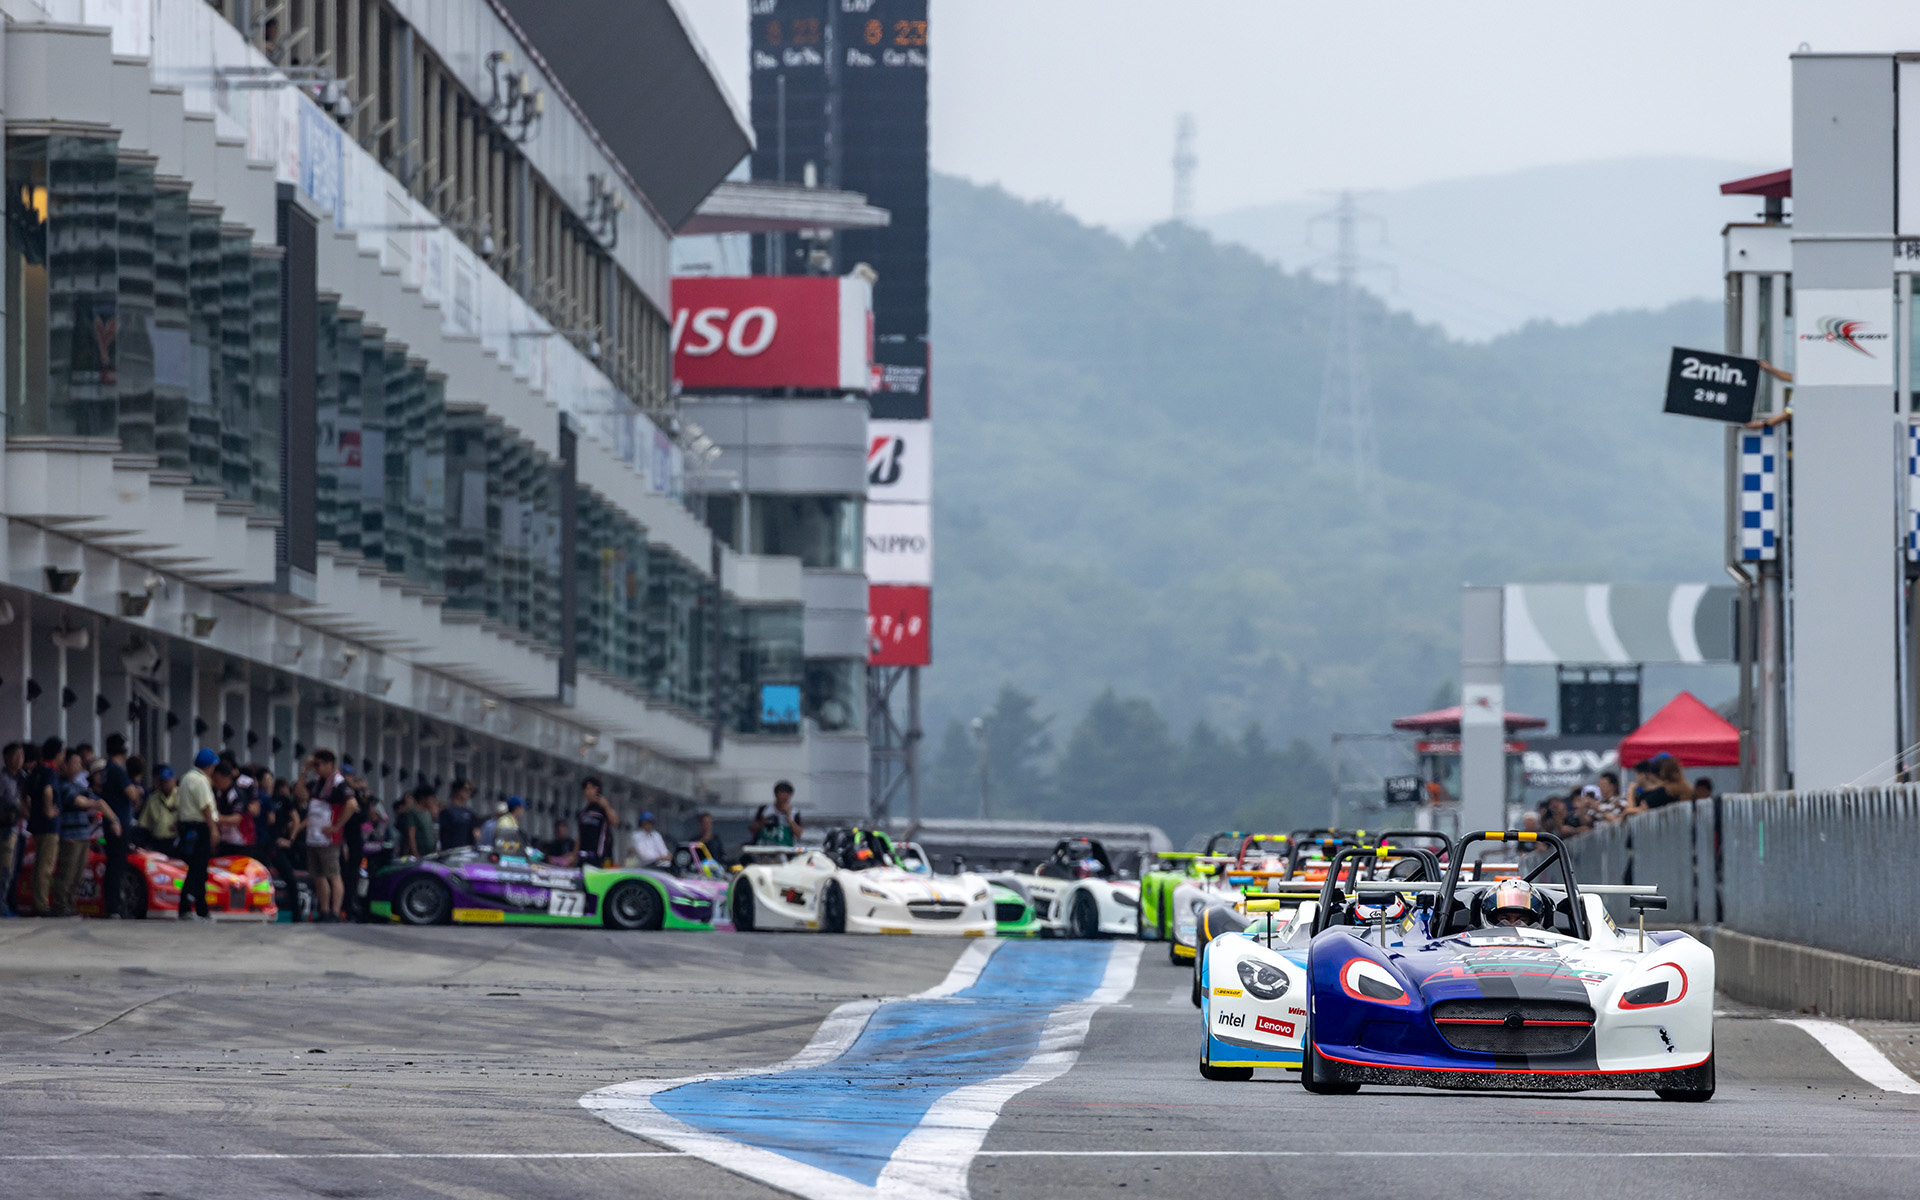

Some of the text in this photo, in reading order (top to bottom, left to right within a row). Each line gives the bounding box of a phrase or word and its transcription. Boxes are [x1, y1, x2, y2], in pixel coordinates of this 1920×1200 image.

[1680, 356, 1747, 387] 2min.
[556, 893, 578, 915] 77
[1218, 1010, 1246, 1028] intel
[1258, 1018, 1292, 1034] Lenovo
